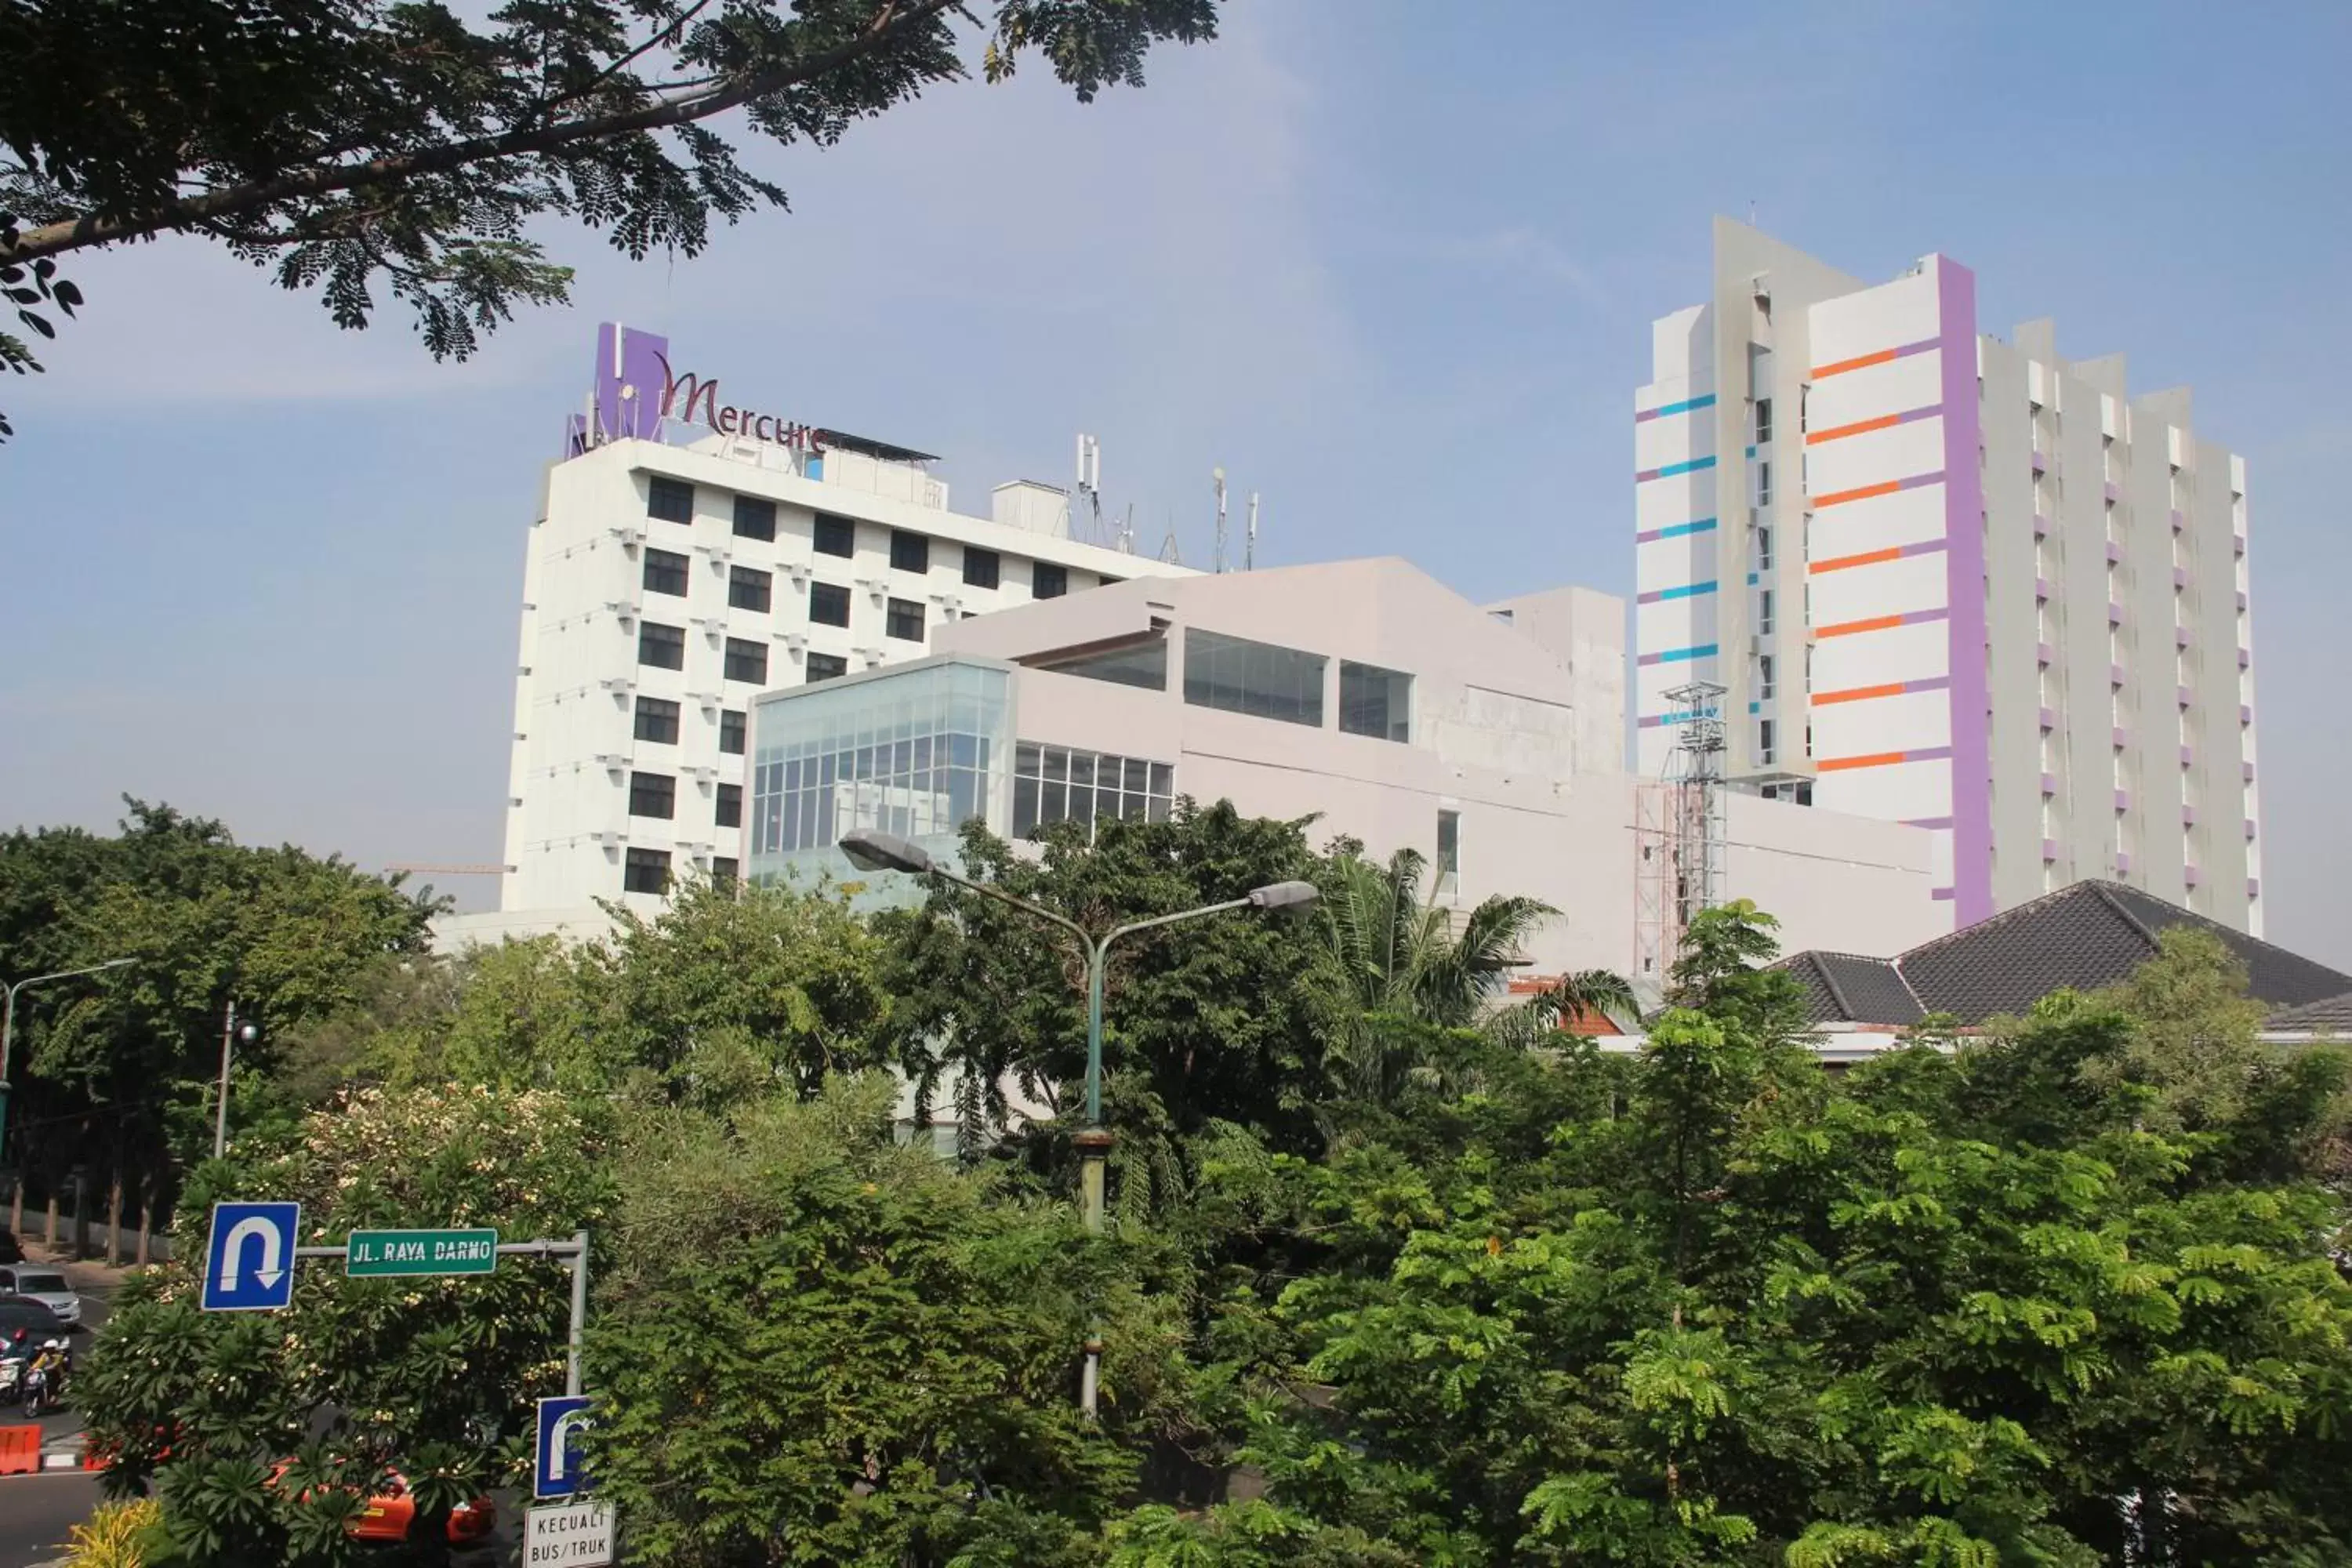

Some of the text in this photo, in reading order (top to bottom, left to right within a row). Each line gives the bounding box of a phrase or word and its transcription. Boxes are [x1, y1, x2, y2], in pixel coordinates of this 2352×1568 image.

[653, 350, 828, 454] Mercure
[353, 1241, 491, 1263] JL. RAYA DARMO
[538, 1512, 604, 1534] KECUALI
[532, 1538, 606, 1563] BUS/TRUK
